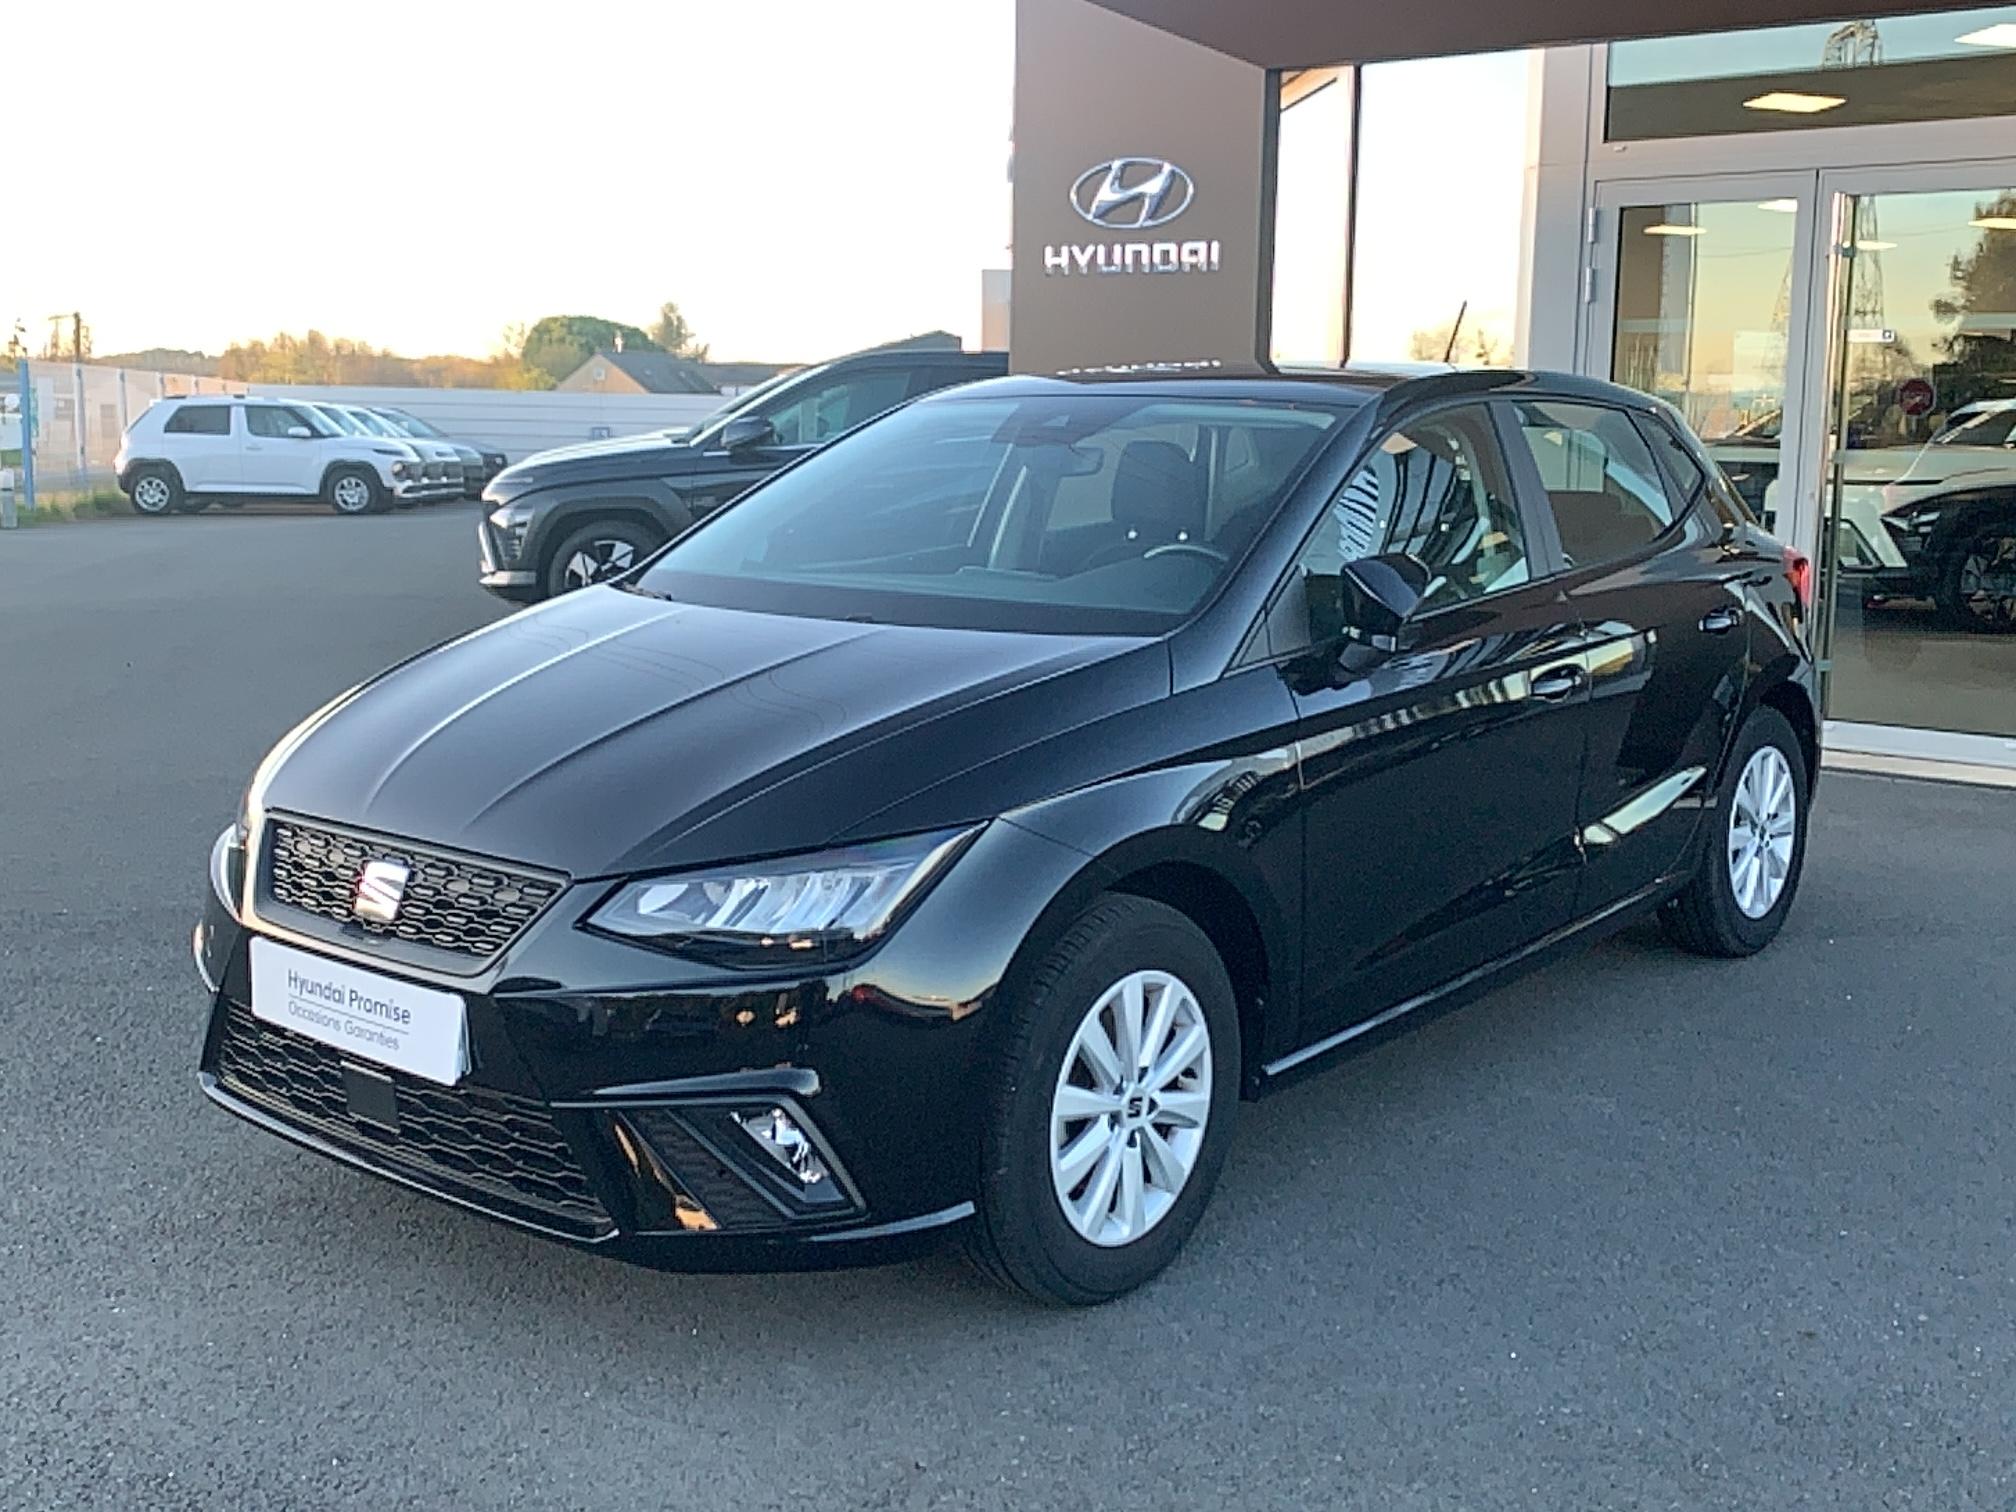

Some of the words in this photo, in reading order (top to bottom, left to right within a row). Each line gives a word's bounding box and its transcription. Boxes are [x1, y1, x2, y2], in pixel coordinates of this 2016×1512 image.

[1043, 240, 1220, 275] HYUNDAI
[287, 968, 346, 1005] Hyundai
[348, 987, 411, 1025] Promise
[288, 999, 342, 1032] Occasions
[344, 1019, 400, 1051] Garanties
